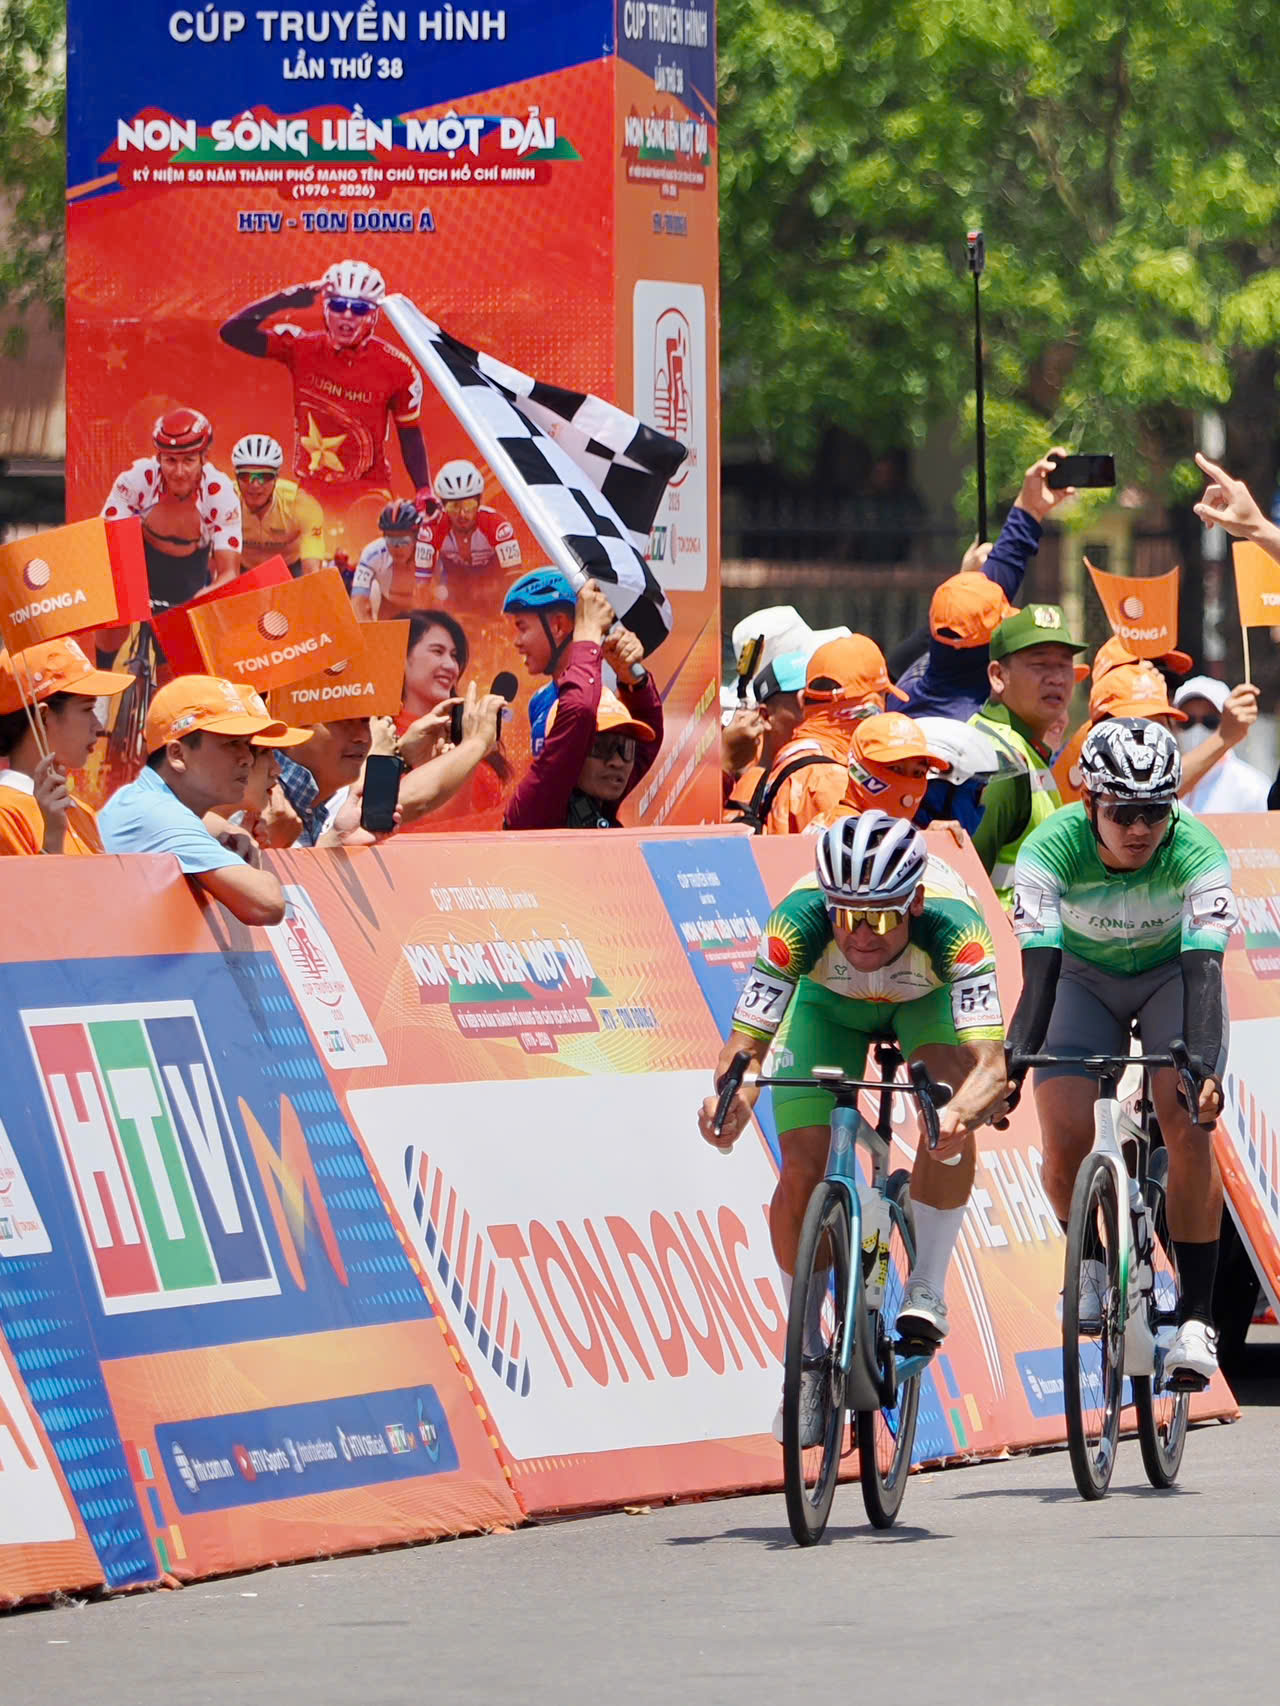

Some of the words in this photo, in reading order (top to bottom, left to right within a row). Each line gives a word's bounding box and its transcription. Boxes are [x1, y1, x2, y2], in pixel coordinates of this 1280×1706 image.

[169, 3, 246, 42] CÚP
[256, 0, 406, 42] TRUYỀN
[418, 2, 506, 41] HÌNH
[283, 48, 325, 80] LẦN
[330, 52, 373, 79] THỨ
[377, 57, 404, 79] 38
[117, 118, 197, 152] NON
[211, 110, 309, 158] SÔNG
[322, 103, 393, 151] LIỀN
[406, 109, 485, 159] MỘT
[500, 105, 556, 157] DẢI
[188, 169, 204, 182] 50
[207, 168, 236, 182] NĂM
[240, 167, 284, 182] THÀNH
[318, 169, 358, 182] MANG
[361, 166, 384, 182] TÊN
[501, 168, 536, 181] MINH
[238, 210, 282, 232] HTV
[9, 609, 30, 626] TON
[30, 592, 73, 617] DONG
[74, 589, 87, 603] A
[1121, 628, 1159, 641] DONG
[1159, 626, 1168, 637] A
[234, 656, 270, 676] TON
[272, 638, 318, 667] DONG
[319, 632, 333, 646] A
[291, 688, 319, 705] TON
[322, 683, 361, 703] DONG
[361, 682, 375, 697] A
[896, 850, 917, 879] MET
[1210, 897, 1229, 920] 2
[401, 943, 453, 987] NON
[744, 980, 784, 1015] 57
[960, 983, 991, 1013] 57
[48, 1062, 245, 1249] HTV
[486, 1217, 656, 1388] TON
[604, 1203, 788, 1378] DONG
